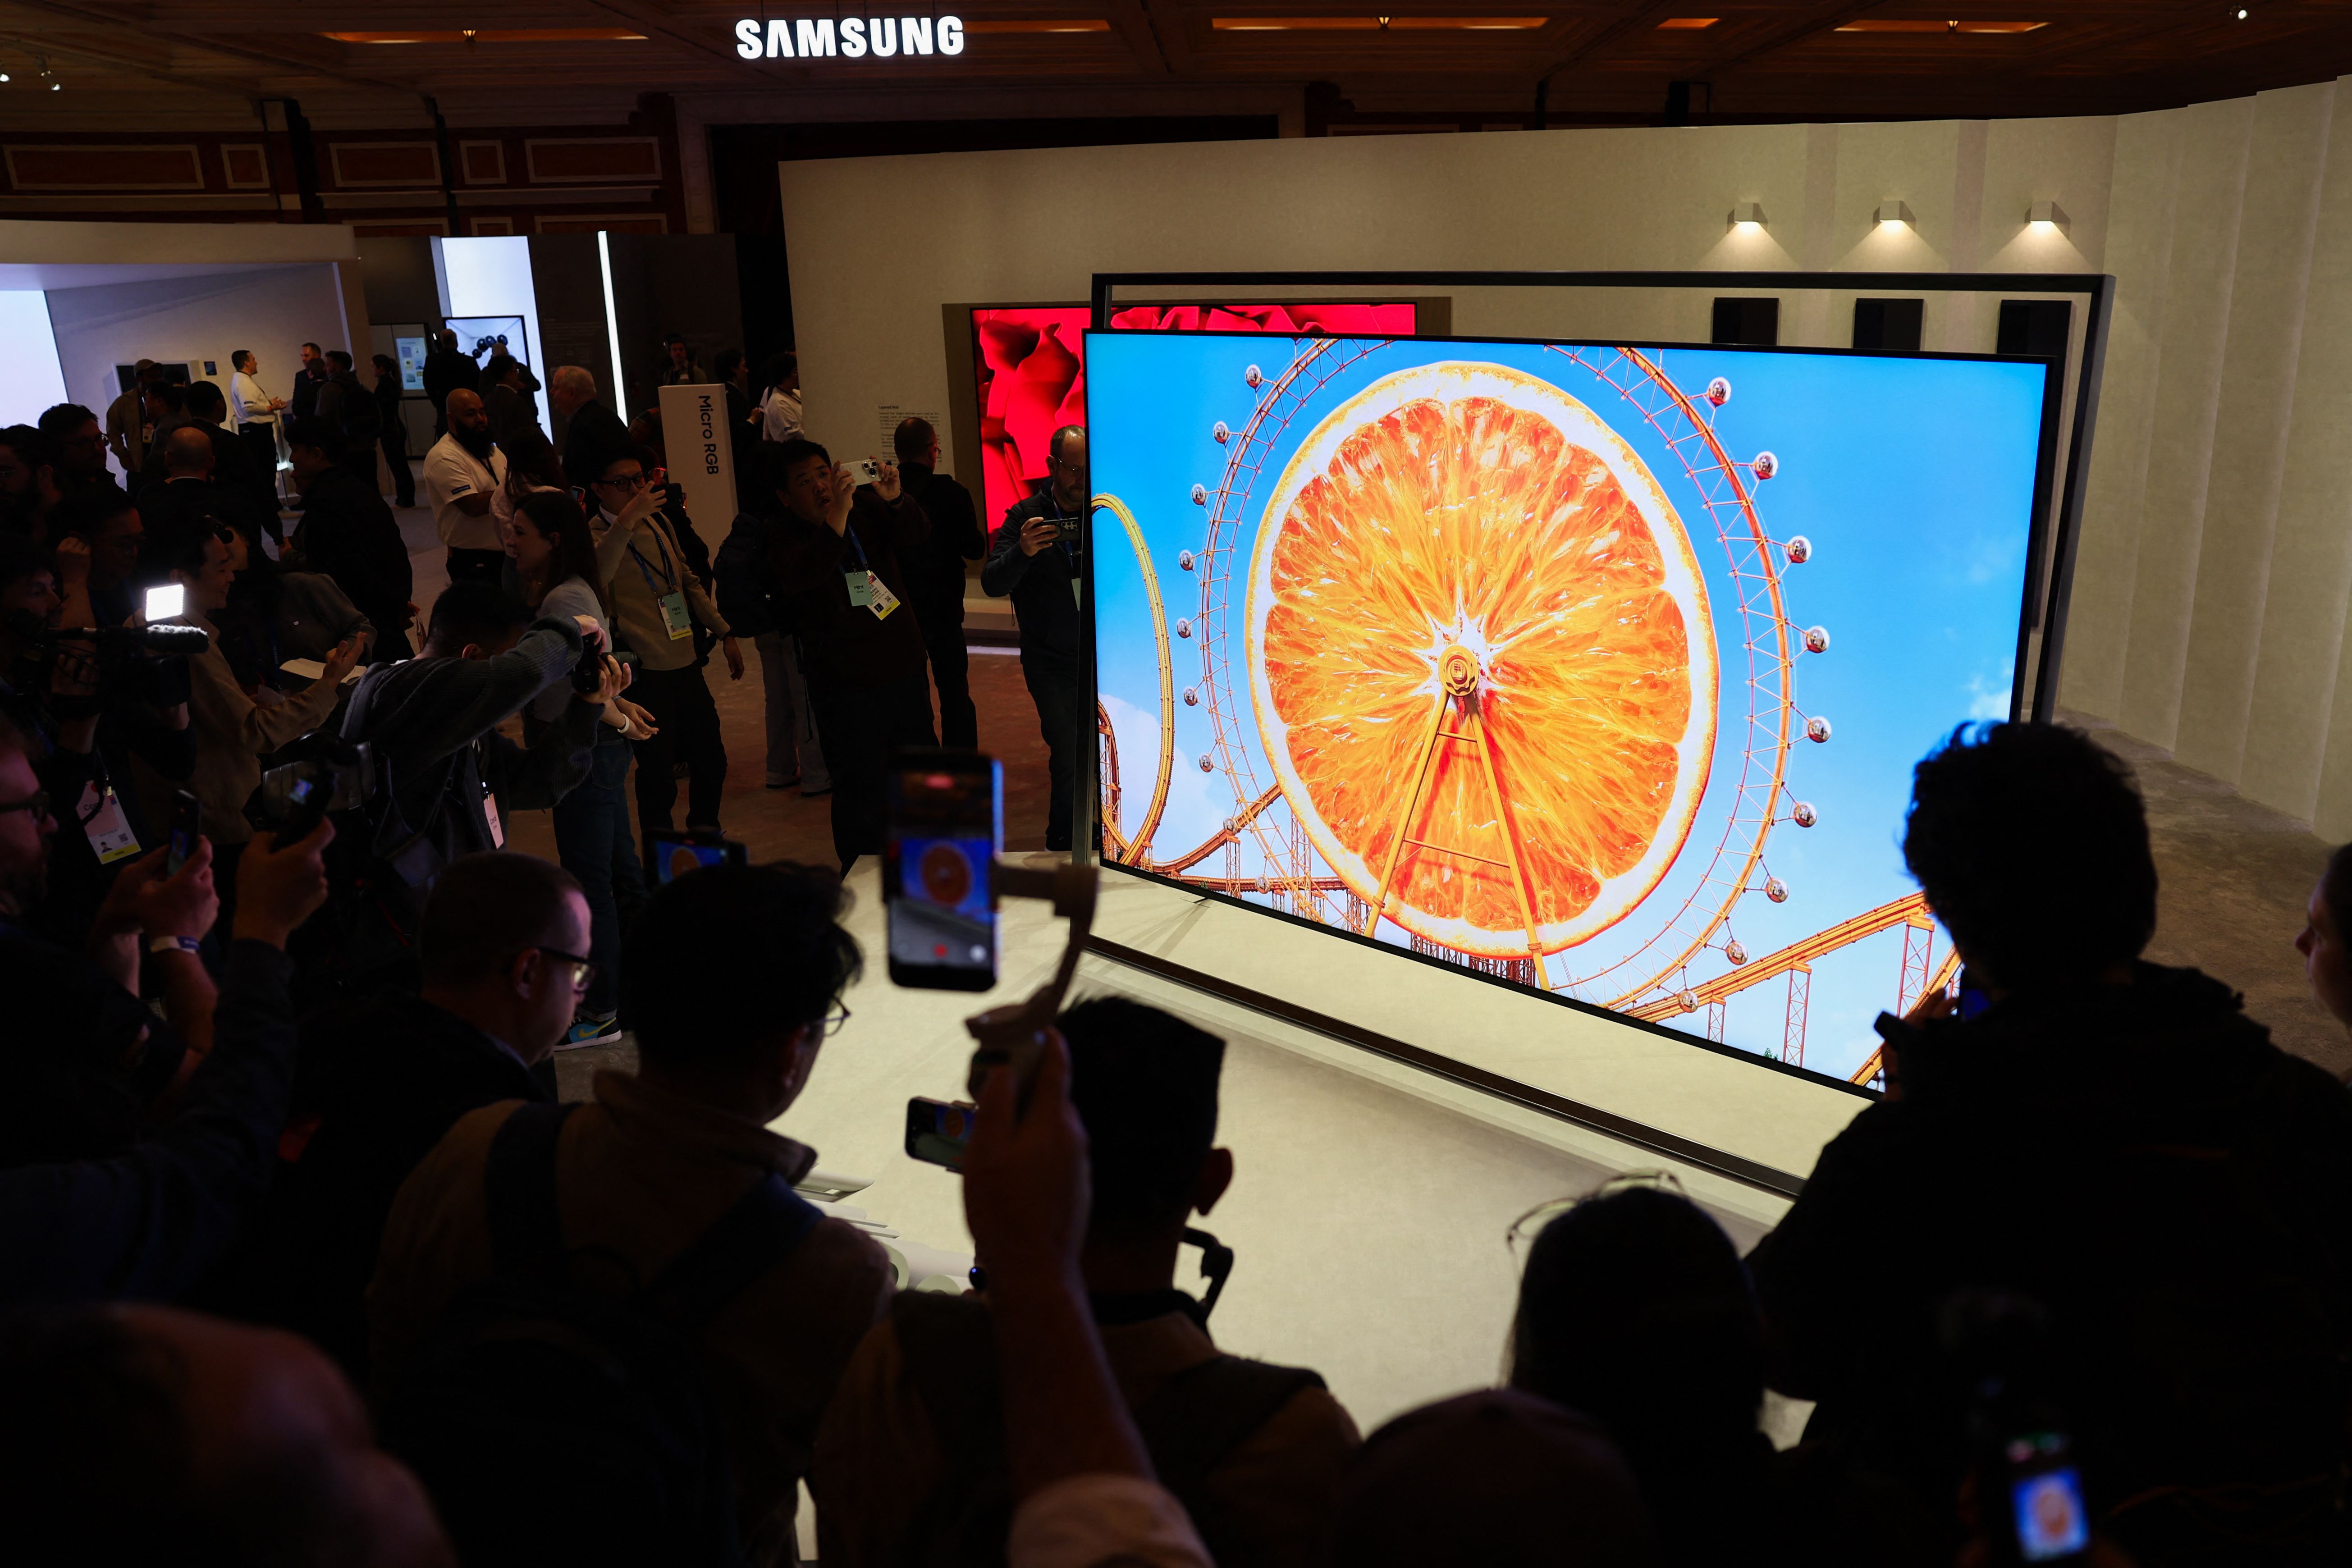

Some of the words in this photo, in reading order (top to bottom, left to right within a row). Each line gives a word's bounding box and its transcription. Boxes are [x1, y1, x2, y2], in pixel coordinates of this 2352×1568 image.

[735, 16, 964, 59] SAMSUNG
[699, 395, 713, 439] Micro
[704, 443, 718, 474] RGB
